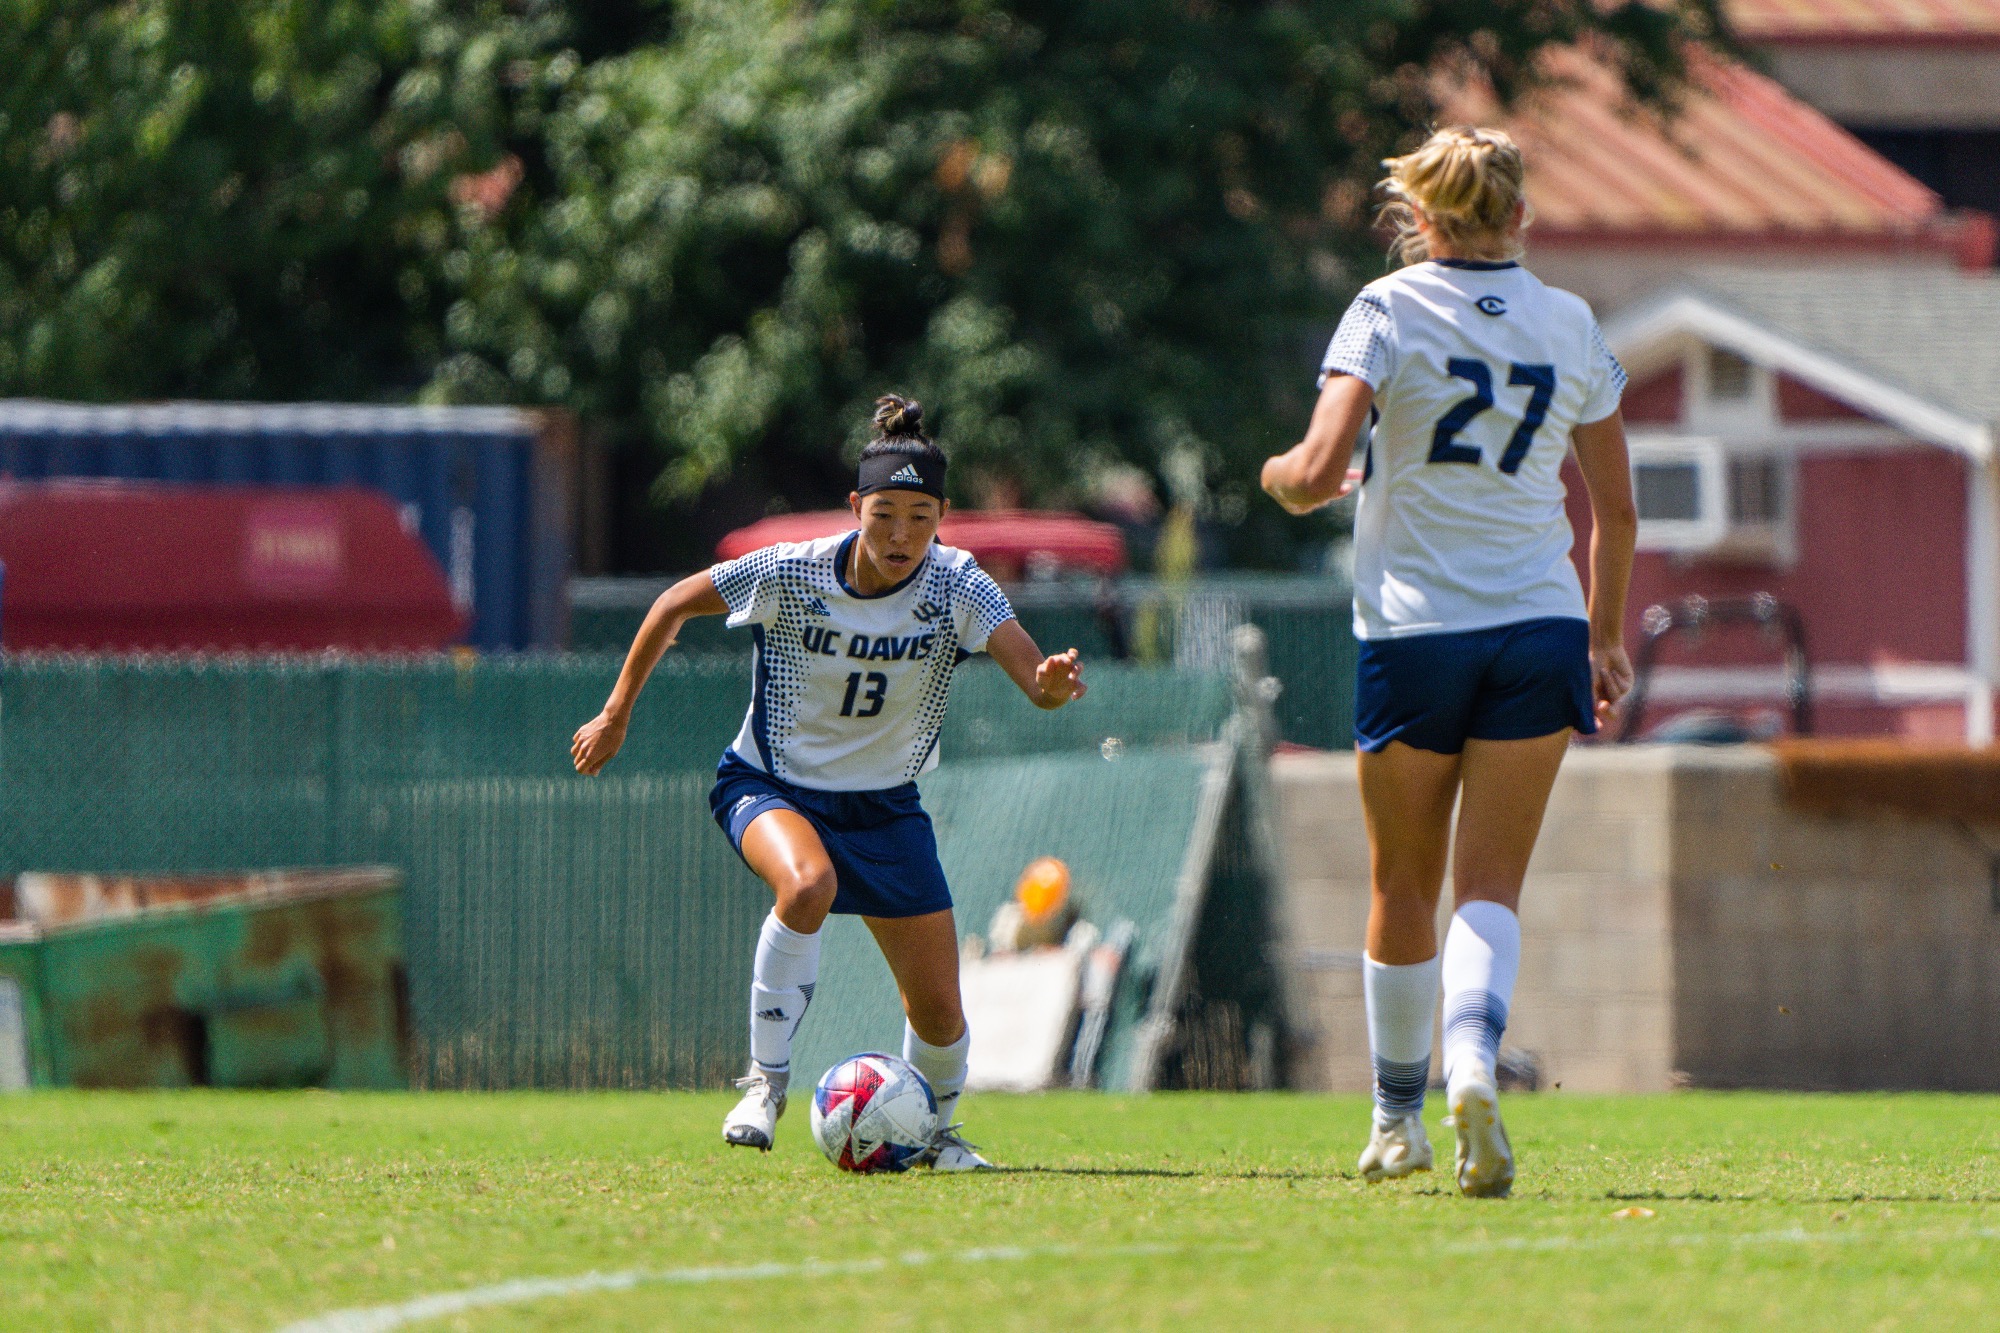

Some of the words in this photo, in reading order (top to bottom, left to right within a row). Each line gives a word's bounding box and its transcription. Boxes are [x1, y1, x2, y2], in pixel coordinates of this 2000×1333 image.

[1427, 356, 1556, 476] 27
[890, 474, 924, 484] adidas
[802, 625, 842, 656] UC
[846, 633, 935, 660] DAVIS
[839, 672, 888, 717] 13
